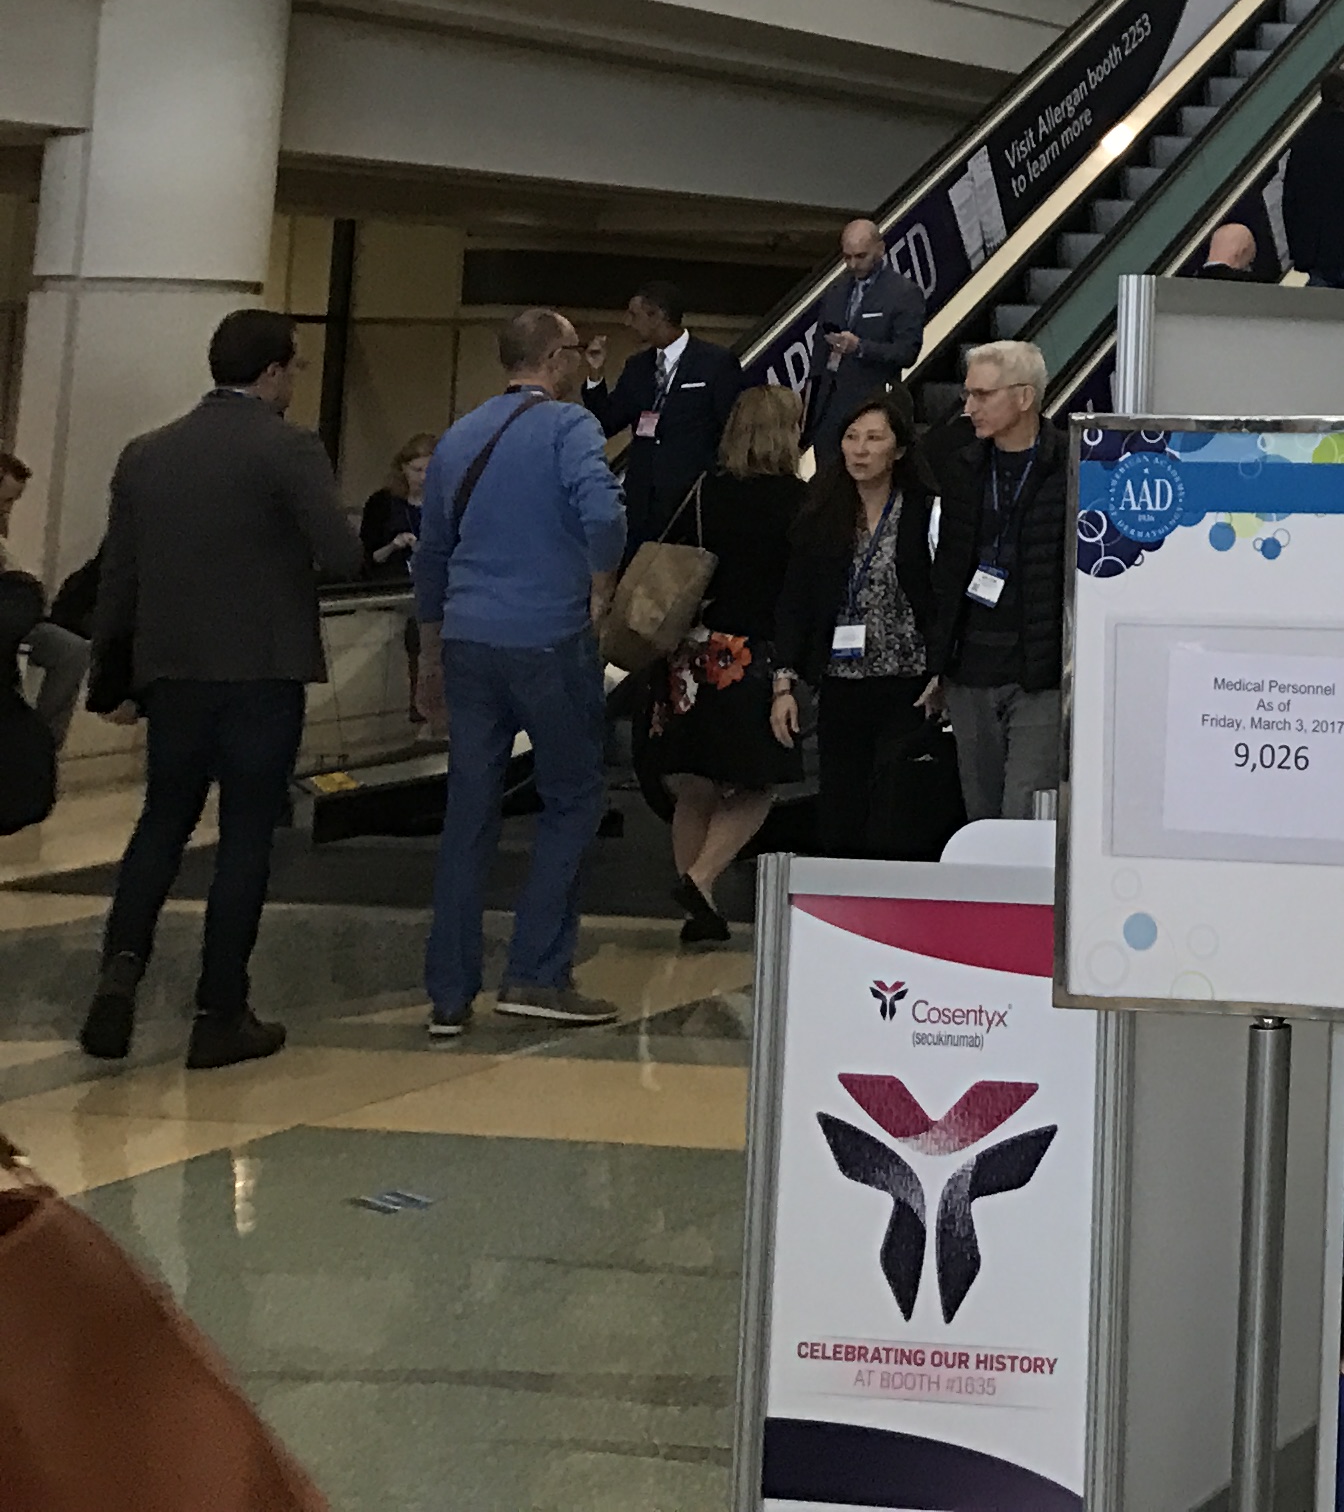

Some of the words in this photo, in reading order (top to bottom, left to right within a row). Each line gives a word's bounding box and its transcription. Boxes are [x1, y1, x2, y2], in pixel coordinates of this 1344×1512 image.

[1004, 128, 1037, 170] Visit
[1038, 80, 1089, 142] Allergan
[1086, 44, 1123, 90] booth
[1121, 12, 1152, 56] 2253
[1010, 174, 1027, 199] to
[1026, 140, 1060, 182] learn
[1060, 108, 1093, 149] more
[1118, 477, 1174, 511] AAD
[1213, 676, 1265, 693] Medical
[1268, 679, 1336, 696] Personnel
[1256, 698, 1275, 712] As
[1277, 699, 1292, 712] of
[1201, 713, 1246, 732] Friday,
[1250, 716, 1292, 732] March
[1295, 718, 1308, 734] 3,
[1233, 742, 1310, 773] 9,026
[911, 999, 1009, 1034] Cosentyx
[911, 1031, 985, 1052] (secukinumab)
[796, 1340, 926, 1368] CELEBRATING
[929, 1350, 971, 1370] OUR
[975, 1352, 1059, 1376] HISTORY
[852, 1369, 876, 1388] AT
[879, 1370, 941, 1392] BOOTH
[946, 1374, 997, 1396] #1635
